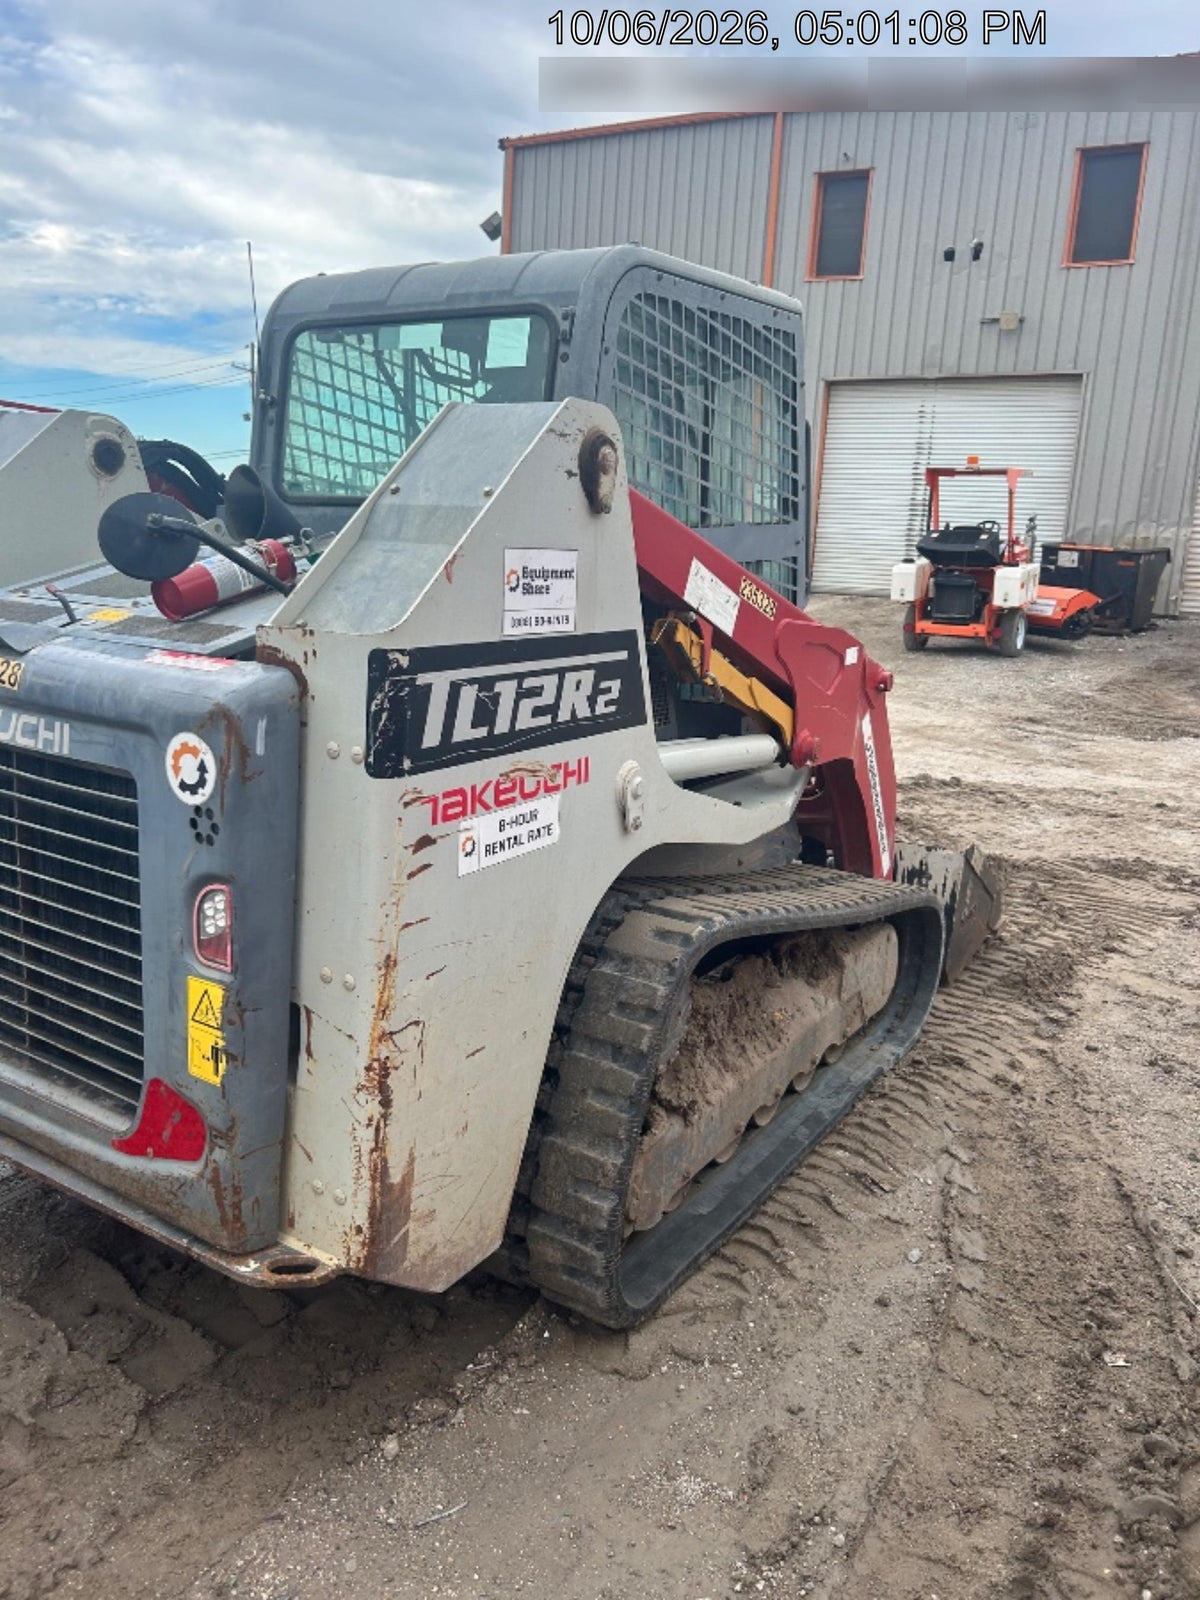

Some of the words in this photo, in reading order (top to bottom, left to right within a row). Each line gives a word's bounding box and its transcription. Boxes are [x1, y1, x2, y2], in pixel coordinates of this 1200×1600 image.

[522, 566, 575, 581] Equipment
[499, 809, 539, 832] 8-HOUR
[484, 834, 525, 857] RENTAL
[527, 823, 554, 843] RATE
